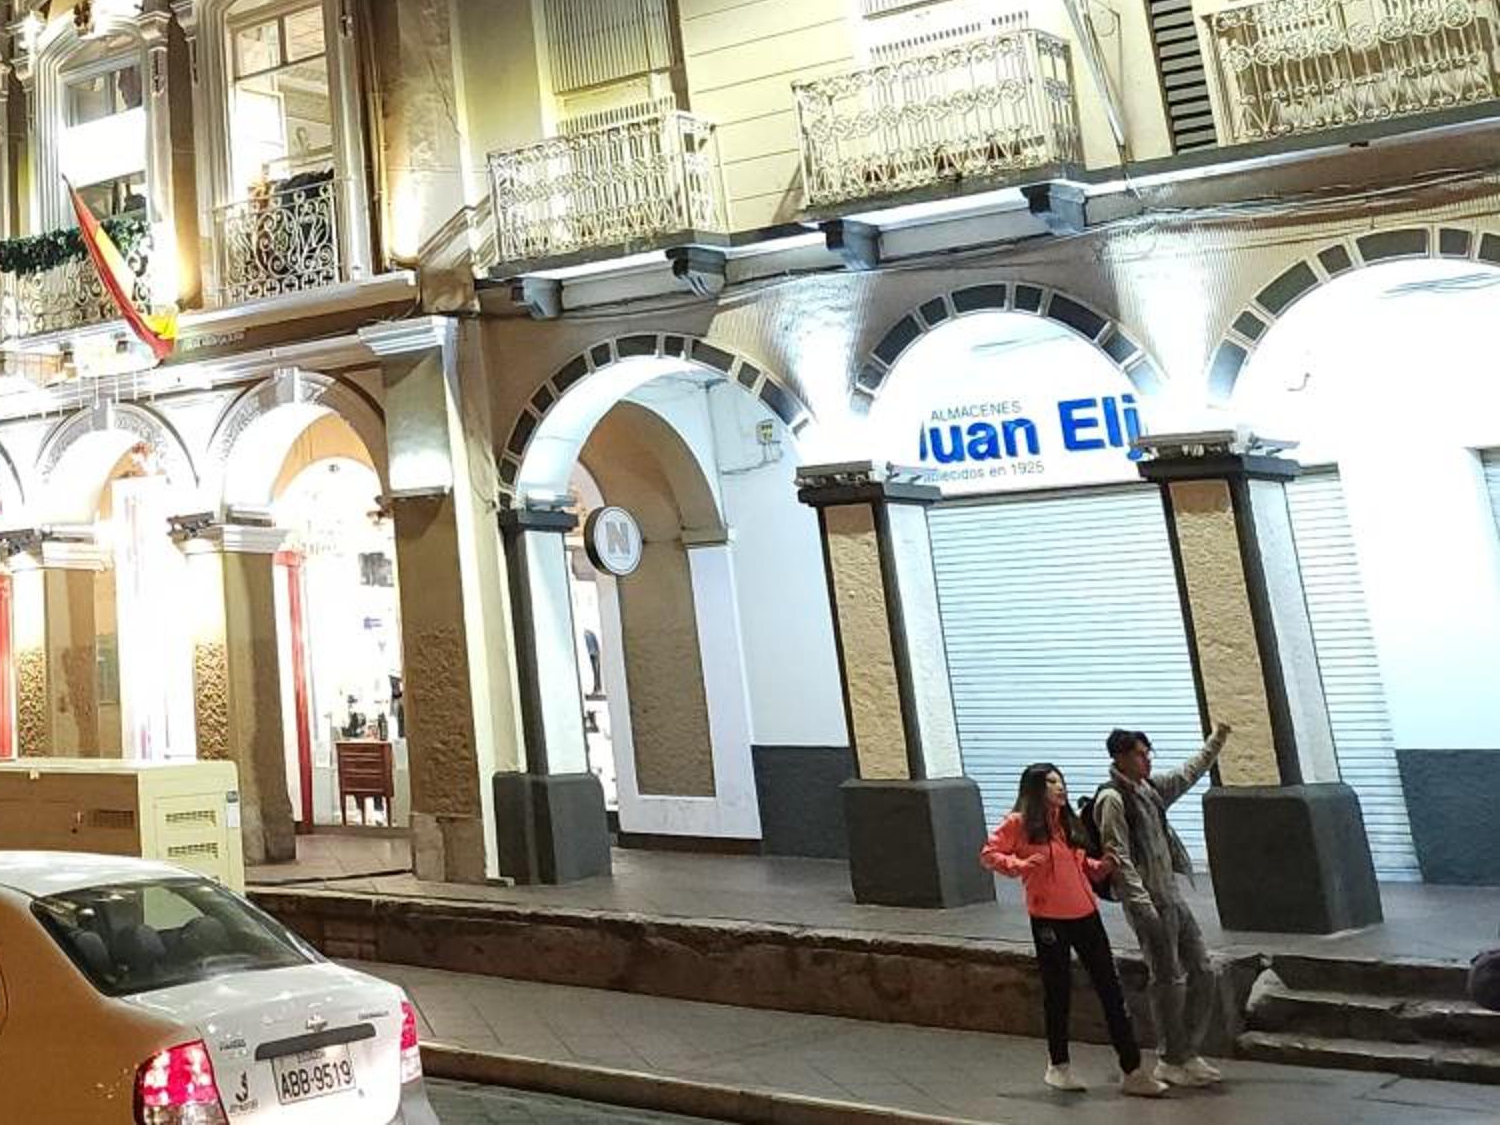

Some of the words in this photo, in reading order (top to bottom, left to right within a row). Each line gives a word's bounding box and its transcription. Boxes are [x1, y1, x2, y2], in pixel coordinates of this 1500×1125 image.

[931, 401, 1021, 421] ALMACENES
[989, 464, 1007, 477] en
[1011, 460, 1045, 475] 1925
[281, 1060, 352, 1099] ABB-9519
